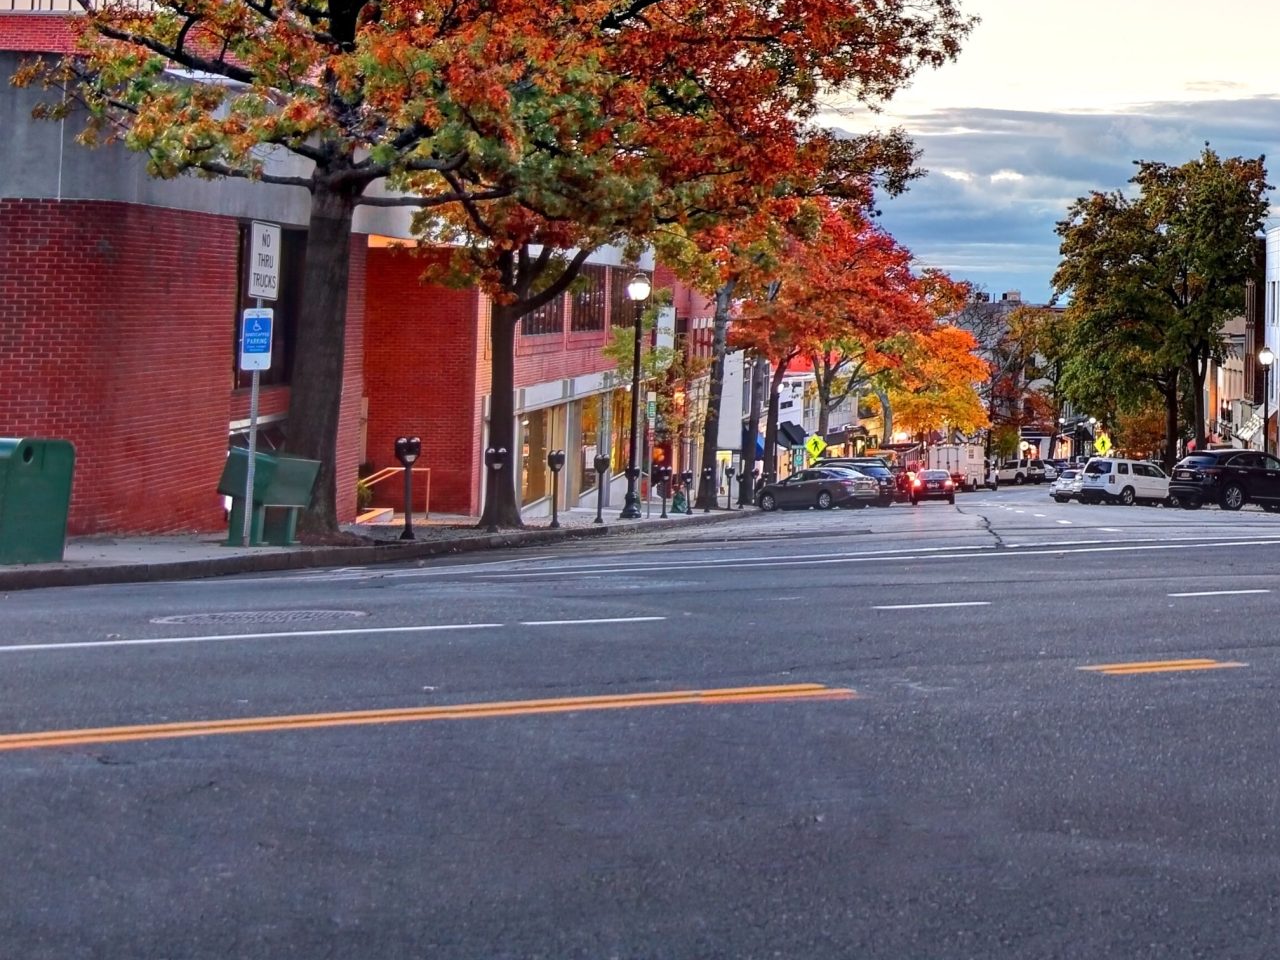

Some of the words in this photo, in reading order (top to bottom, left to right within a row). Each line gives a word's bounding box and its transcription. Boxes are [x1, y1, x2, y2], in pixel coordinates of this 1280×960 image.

[262, 234, 271, 247] NO
[258, 252, 274, 268] THRU
[253, 272, 276, 289] TRUCKS
